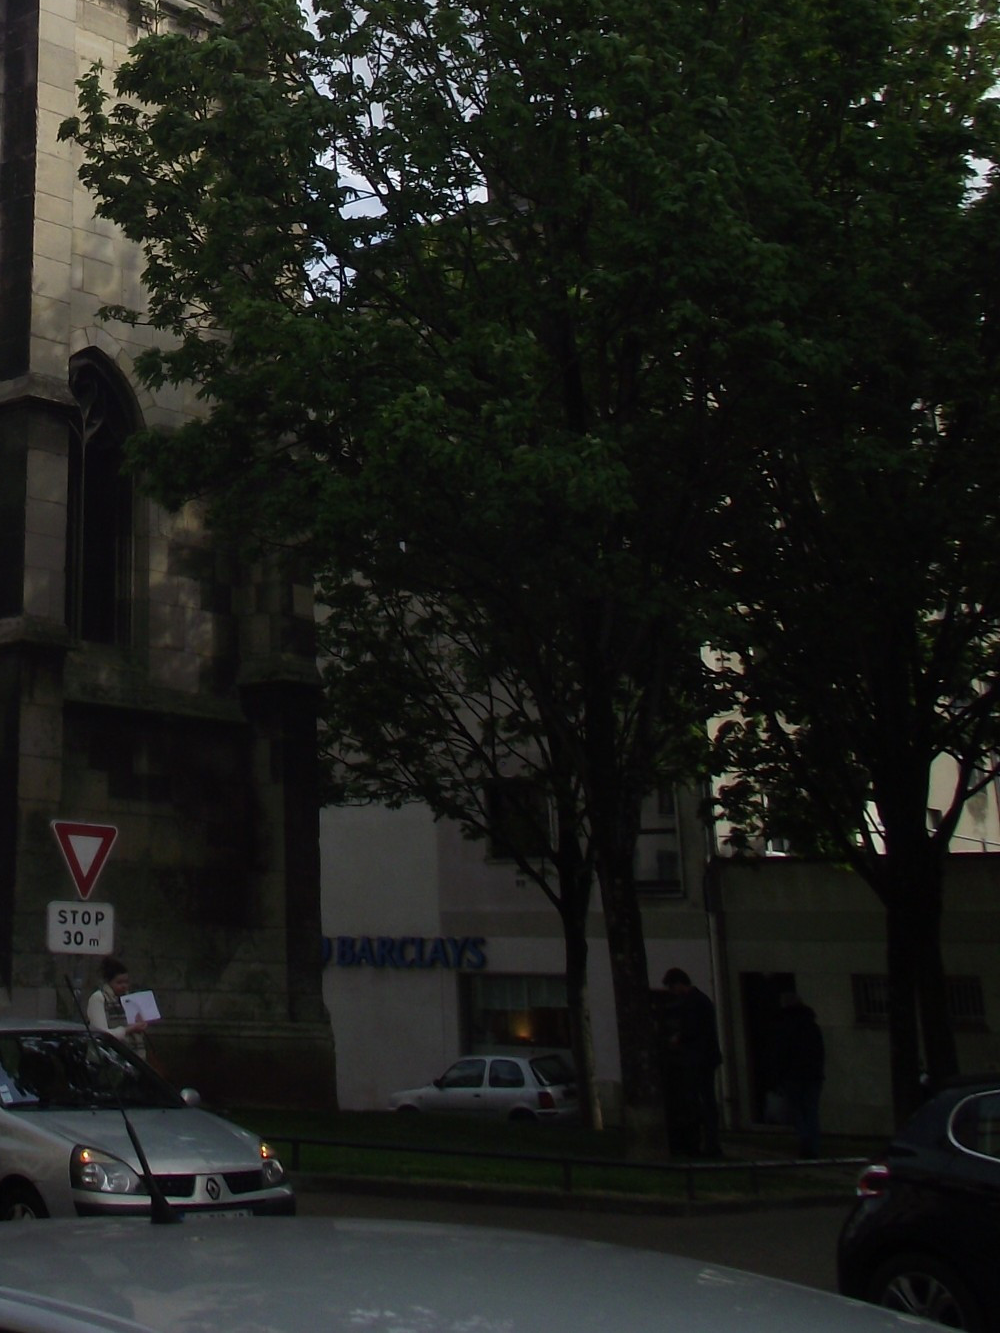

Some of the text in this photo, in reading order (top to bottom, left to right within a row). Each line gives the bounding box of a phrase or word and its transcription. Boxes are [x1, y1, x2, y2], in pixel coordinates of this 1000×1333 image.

[58, 909, 105, 926] STOP
[63, 930, 100, 947] 30 m
[336, 936, 488, 970] BARCLAYS
